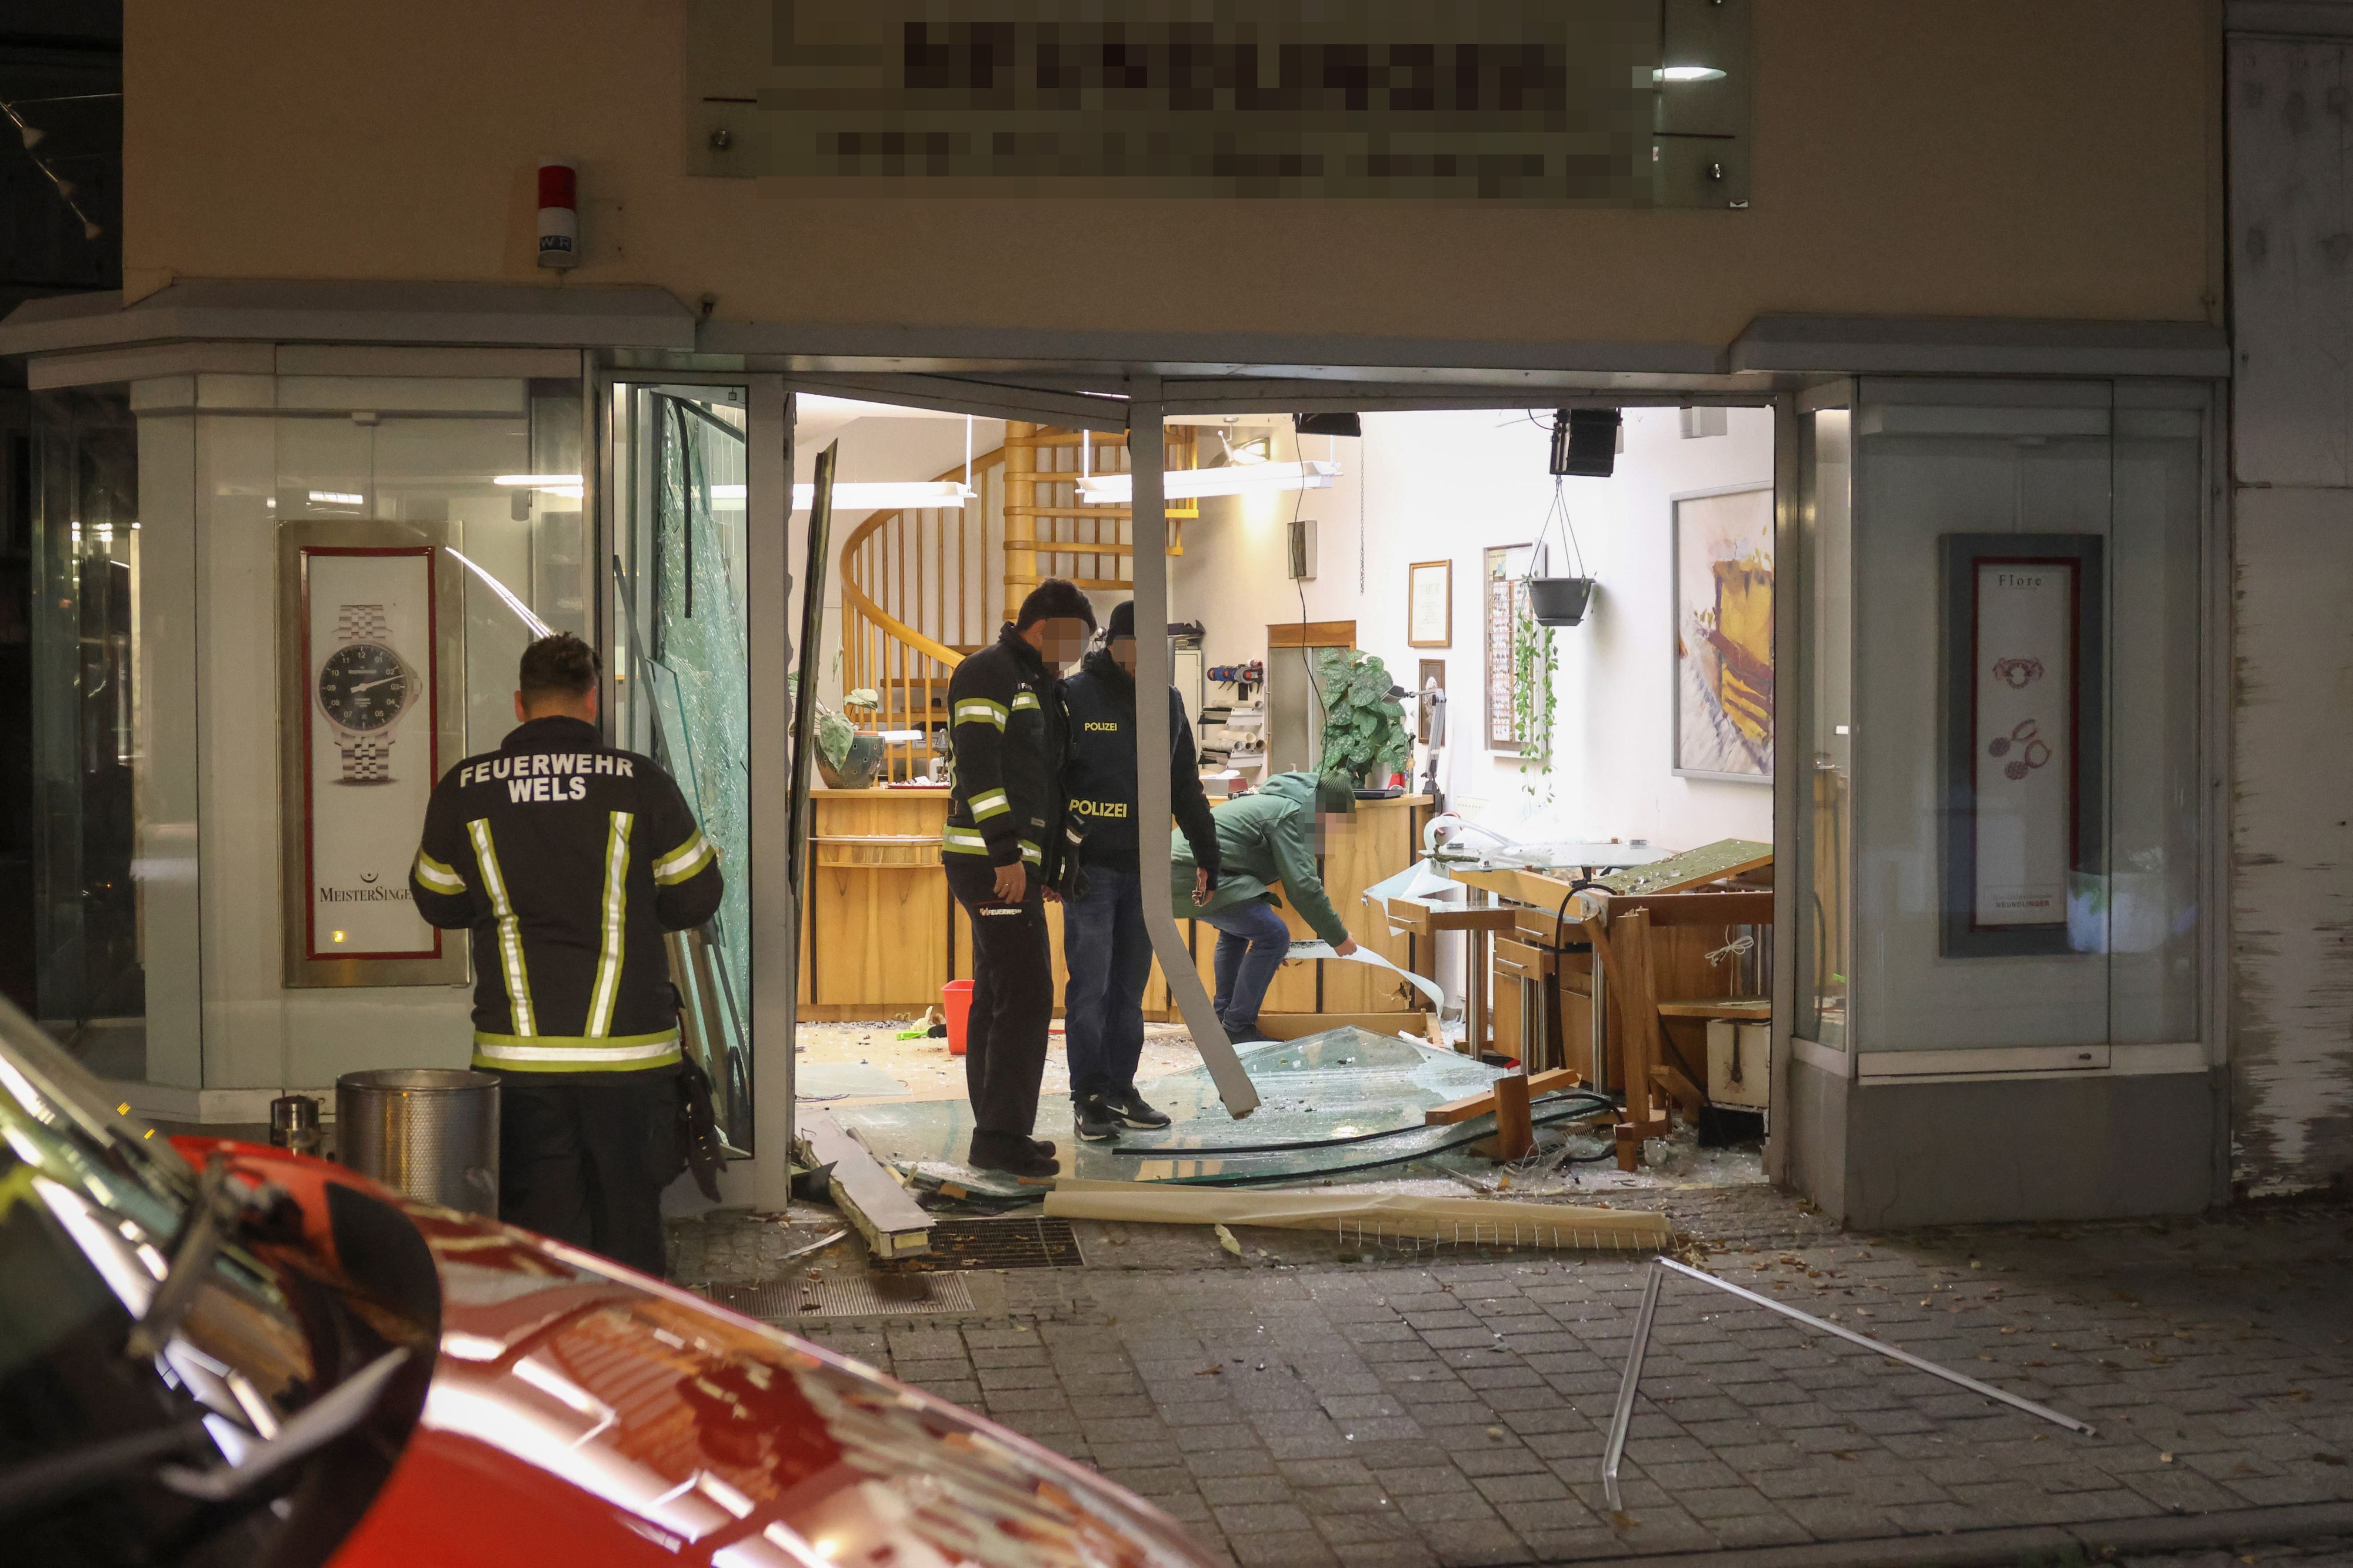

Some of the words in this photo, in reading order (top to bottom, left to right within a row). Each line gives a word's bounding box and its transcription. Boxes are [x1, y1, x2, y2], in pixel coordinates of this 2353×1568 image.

[1085, 722, 1118, 731] POLIZEI
[459, 753, 635, 788] FEUERWEHR
[507, 776, 586, 803] WELS
[1068, 799, 1128, 818] POLIZEI
[320, 886, 412, 902] MEISTERSINGE
